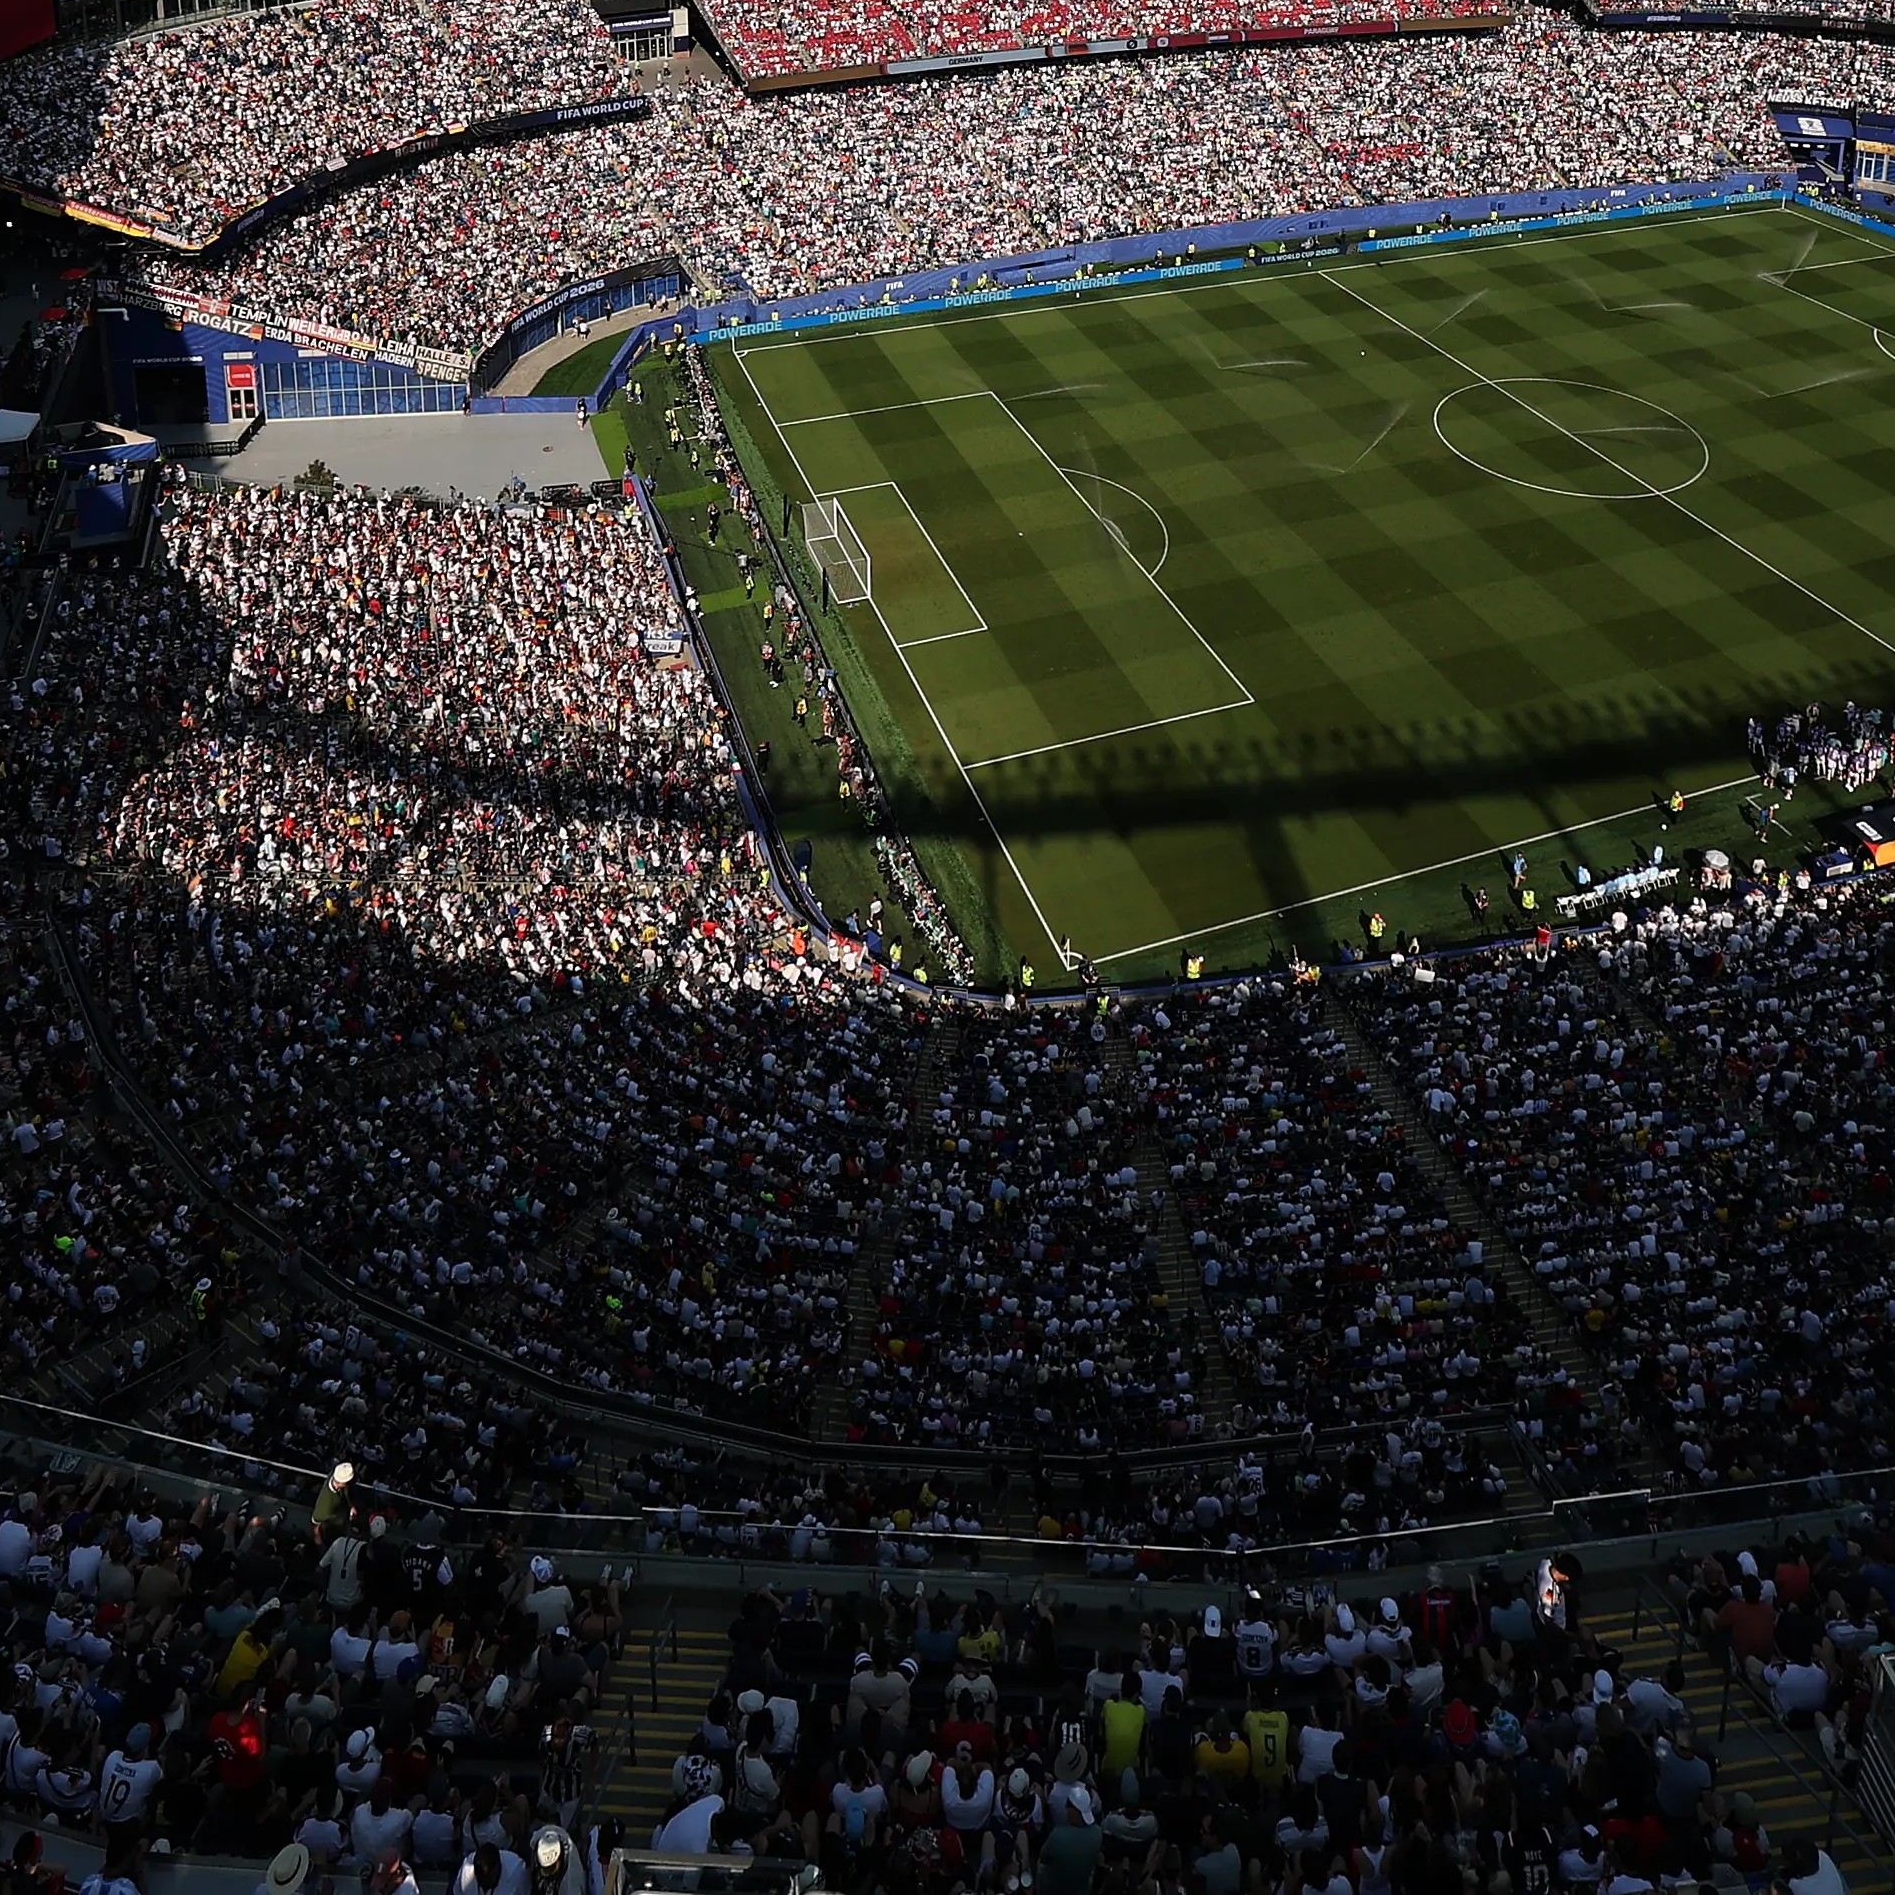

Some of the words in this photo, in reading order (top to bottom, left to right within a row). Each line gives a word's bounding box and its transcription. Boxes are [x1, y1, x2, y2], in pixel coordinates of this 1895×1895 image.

[1304, 26, 1340, 36] PARAGUAY
[948, 55, 983, 67] GERMANY
[1767, 88, 1803, 103] NEUSS
[556, 109, 580, 121] FIFA
[582, 103, 620, 117] WORLD
[621, 99, 644, 111] CUP
[394, 137, 439, 157] BOSTON
[1610, 189, 1626, 198] FIFA
[1723, 190, 1773, 205] POWERADE
[1642, 200, 1693, 216] POWERADE
[1809, 197, 1864, 225] POWERADE
[1556, 210, 1609, 226] POWERADE
[1468, 222, 1522, 238] POWERADE
[1376, 234, 1433, 250] POWERADE
[1261, 255, 1276, 264] FIFA
[1277, 252, 1300, 263] WORLD
[1300, 250, 1315, 259] CUP
[1315, 247, 1340, 257] 2026
[1160, 261, 1222, 277] POWERADE
[886, 281, 904, 291] FIFA
[1056, 276, 1121, 292] POWERADE
[120, 294, 183, 317] HARZBURG
[510, 316, 525, 334] FIFA
[525, 299, 553, 326] WORLD
[554, 290, 570, 307] CUP
[569, 279, 606, 299] 2026
[945, 289, 1012, 307] POWERADE
[188, 308, 250, 336] ROGÄTZ
[231, 306, 288, 328] TEMPLIN
[829, 305, 899, 323] POWERADE
[265, 326, 293, 343] ERDA
[709, 320, 782, 342] POWERADE
[294, 333, 368, 361] BRACHELEN
[378, 338, 415, 356] LEIHA
[419, 348, 451, 363] HALLE
[374, 351, 415, 368] HADERN
[417, 362, 460, 381] SPENGE
[412, 1567, 424, 1593] 5
[1246, 1646, 1260, 1668] 8
[1263, 1736, 1277, 1767] 9
[104, 1774, 131, 1806] 19
